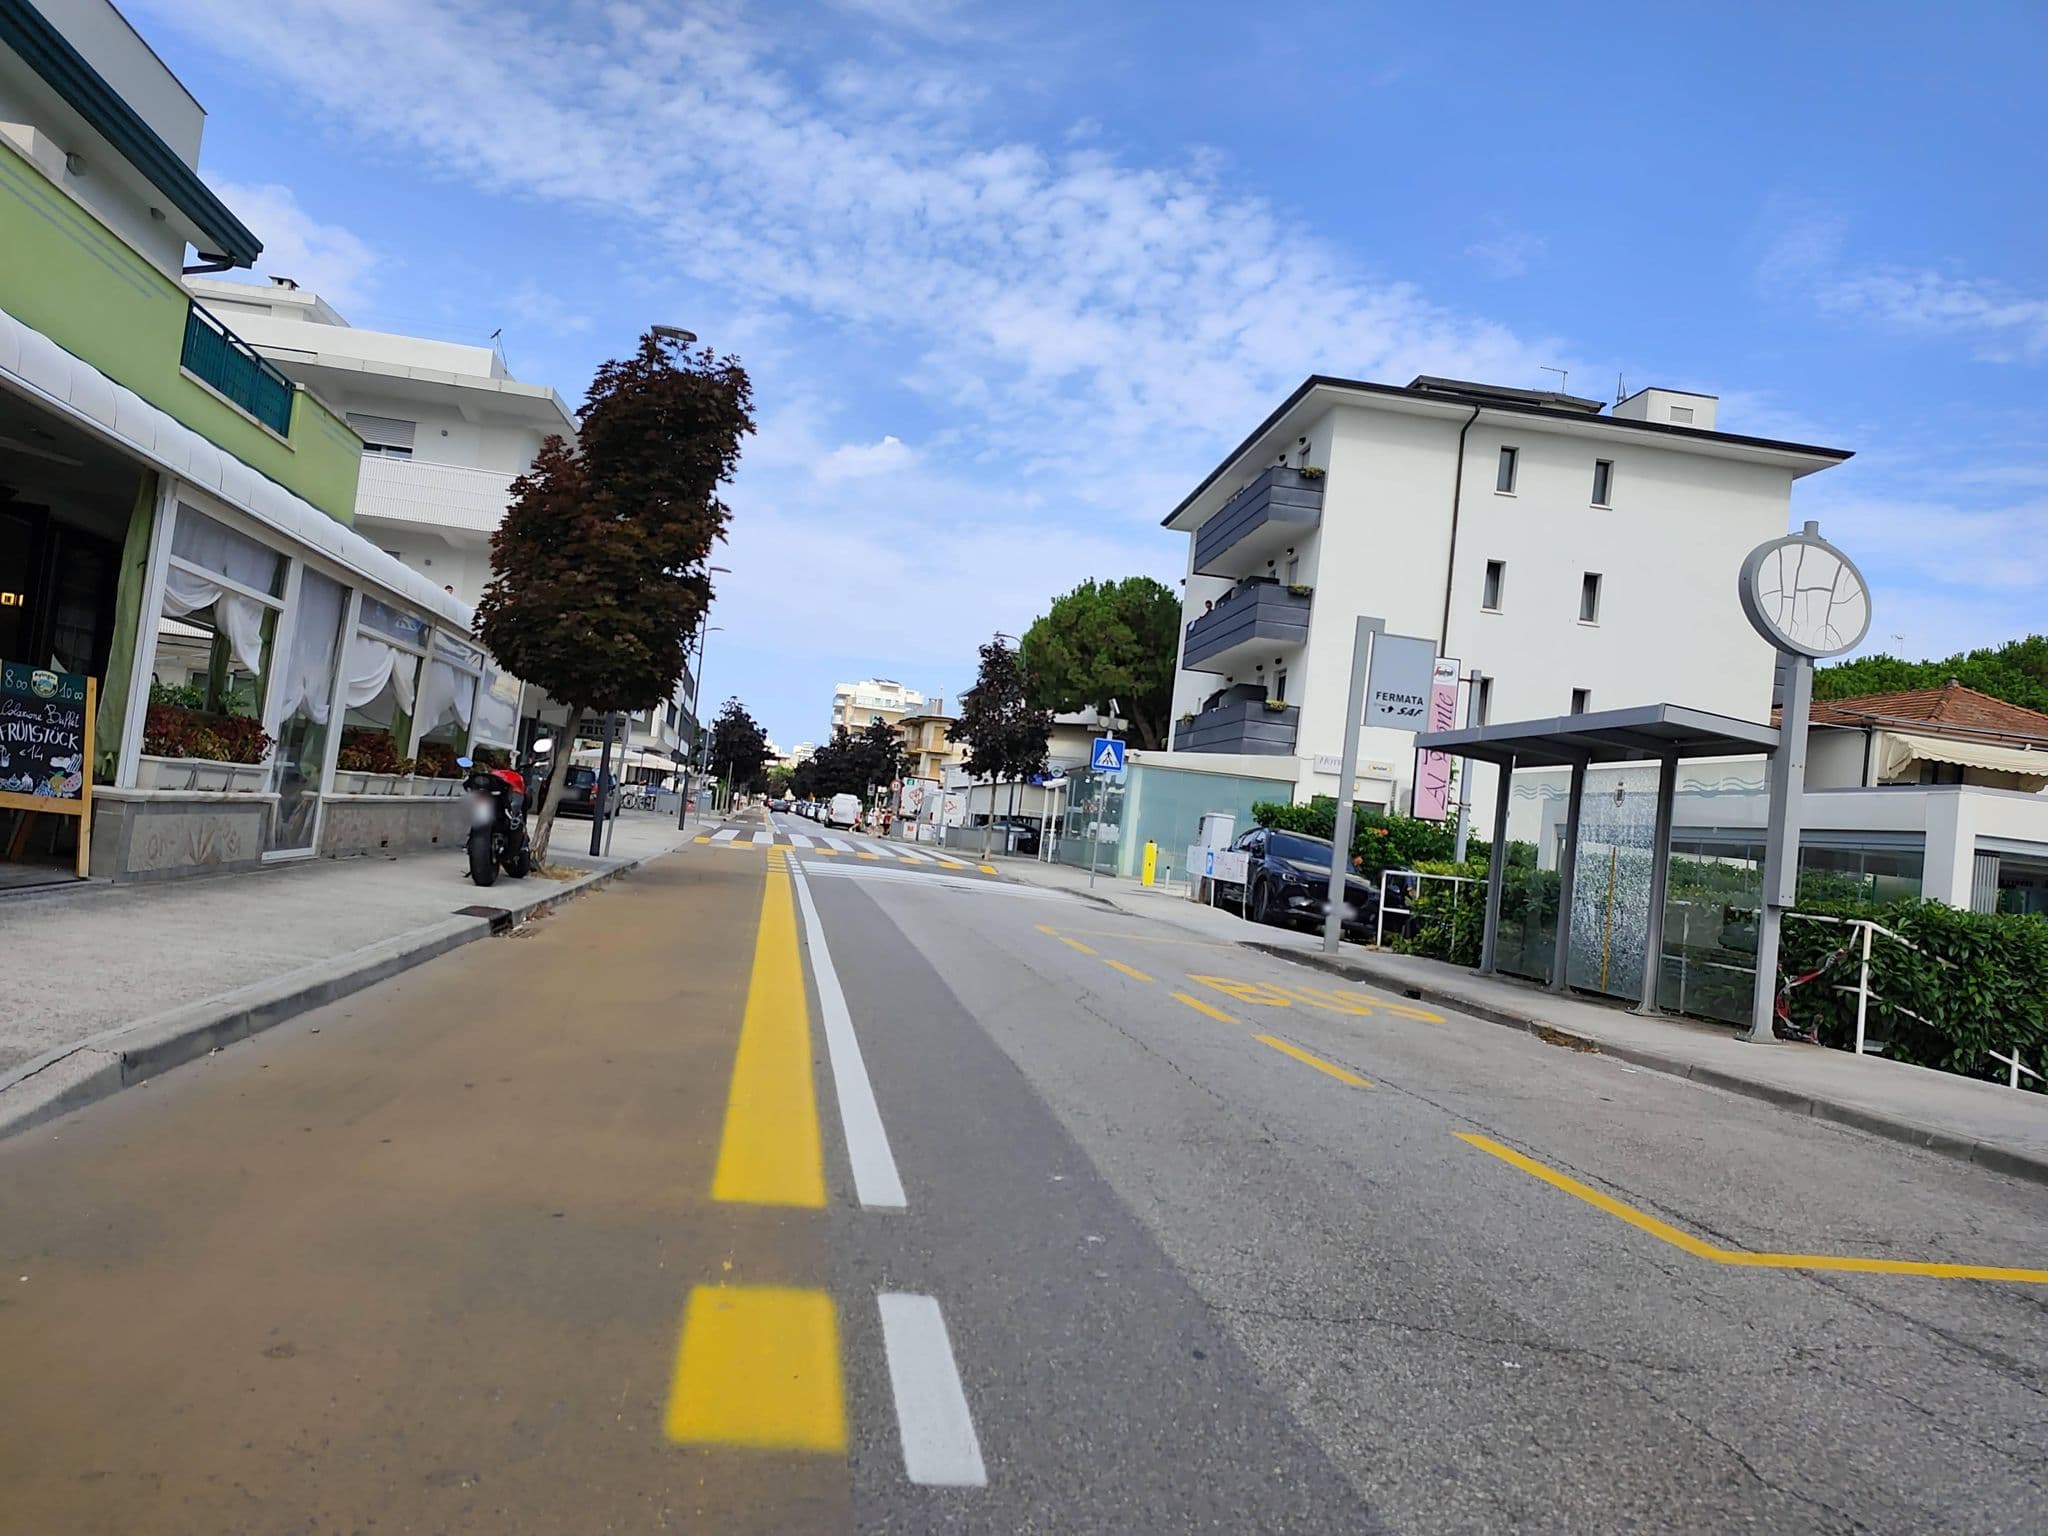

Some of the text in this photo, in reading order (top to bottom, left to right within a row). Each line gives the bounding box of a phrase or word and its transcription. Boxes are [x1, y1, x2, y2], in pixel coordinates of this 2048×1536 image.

[1375, 691, 1424, 705] FERMATA
[0, 698, 80, 729] Colazione Buffet
[1396, 707, 1424, 717] SAF
[579, 725, 619, 737] FRIUI
[1424, 772, 1447, 811] Al
[1183, 973, 1448, 1024] BUS
